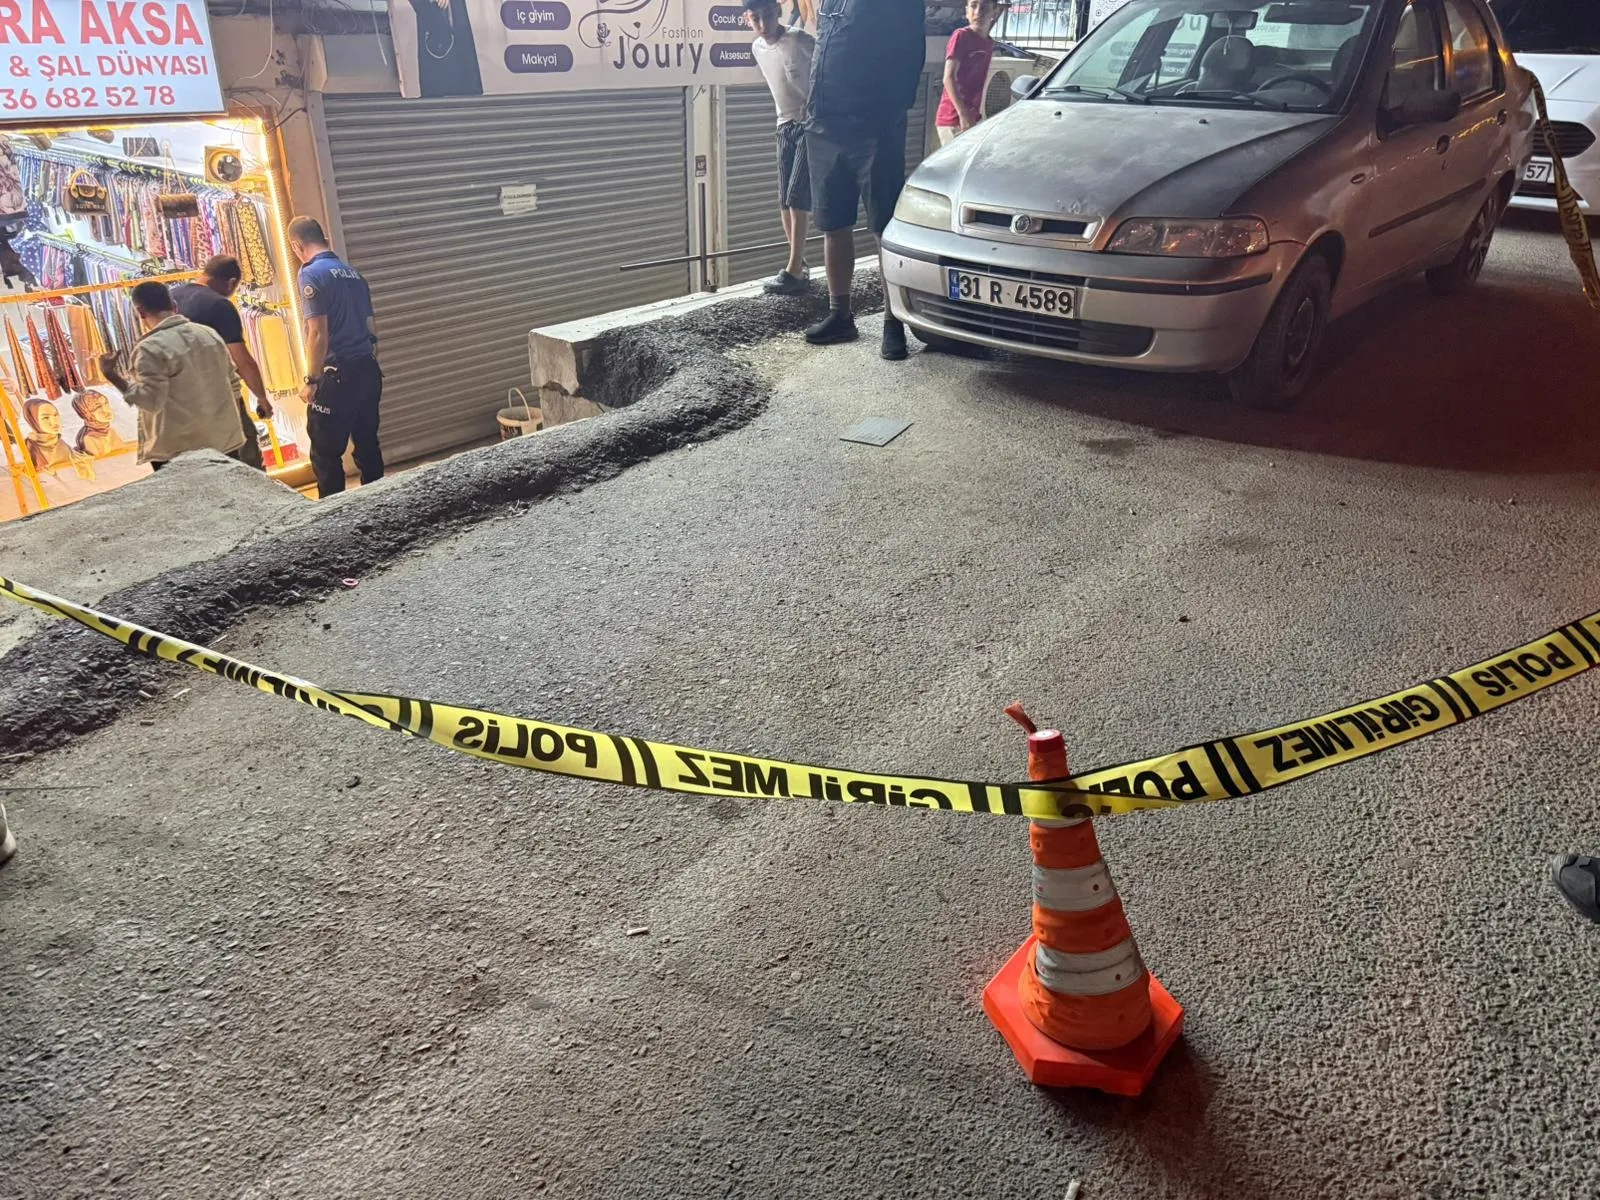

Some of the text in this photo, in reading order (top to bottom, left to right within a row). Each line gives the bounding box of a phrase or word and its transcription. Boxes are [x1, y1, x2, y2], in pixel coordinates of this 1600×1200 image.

[0, 0, 204, 46] RA AKSA
[528, 9, 555, 24] giyim
[712, 13, 736, 27] Çocuk
[521, 52, 557, 67] Makyaj
[613, 35, 704, 74] Joury
[719, 50, 752, 60] Aksesuar
[9, 50, 208, 81] & ŞAL DÜNYASI
[45, 87, 99, 109] 682
[105, 86, 138, 107] 52
[143, 85, 176, 106] 78
[1526, 165, 1546, 179] 57
[959, 275, 1073, 314] 31 R 4589
